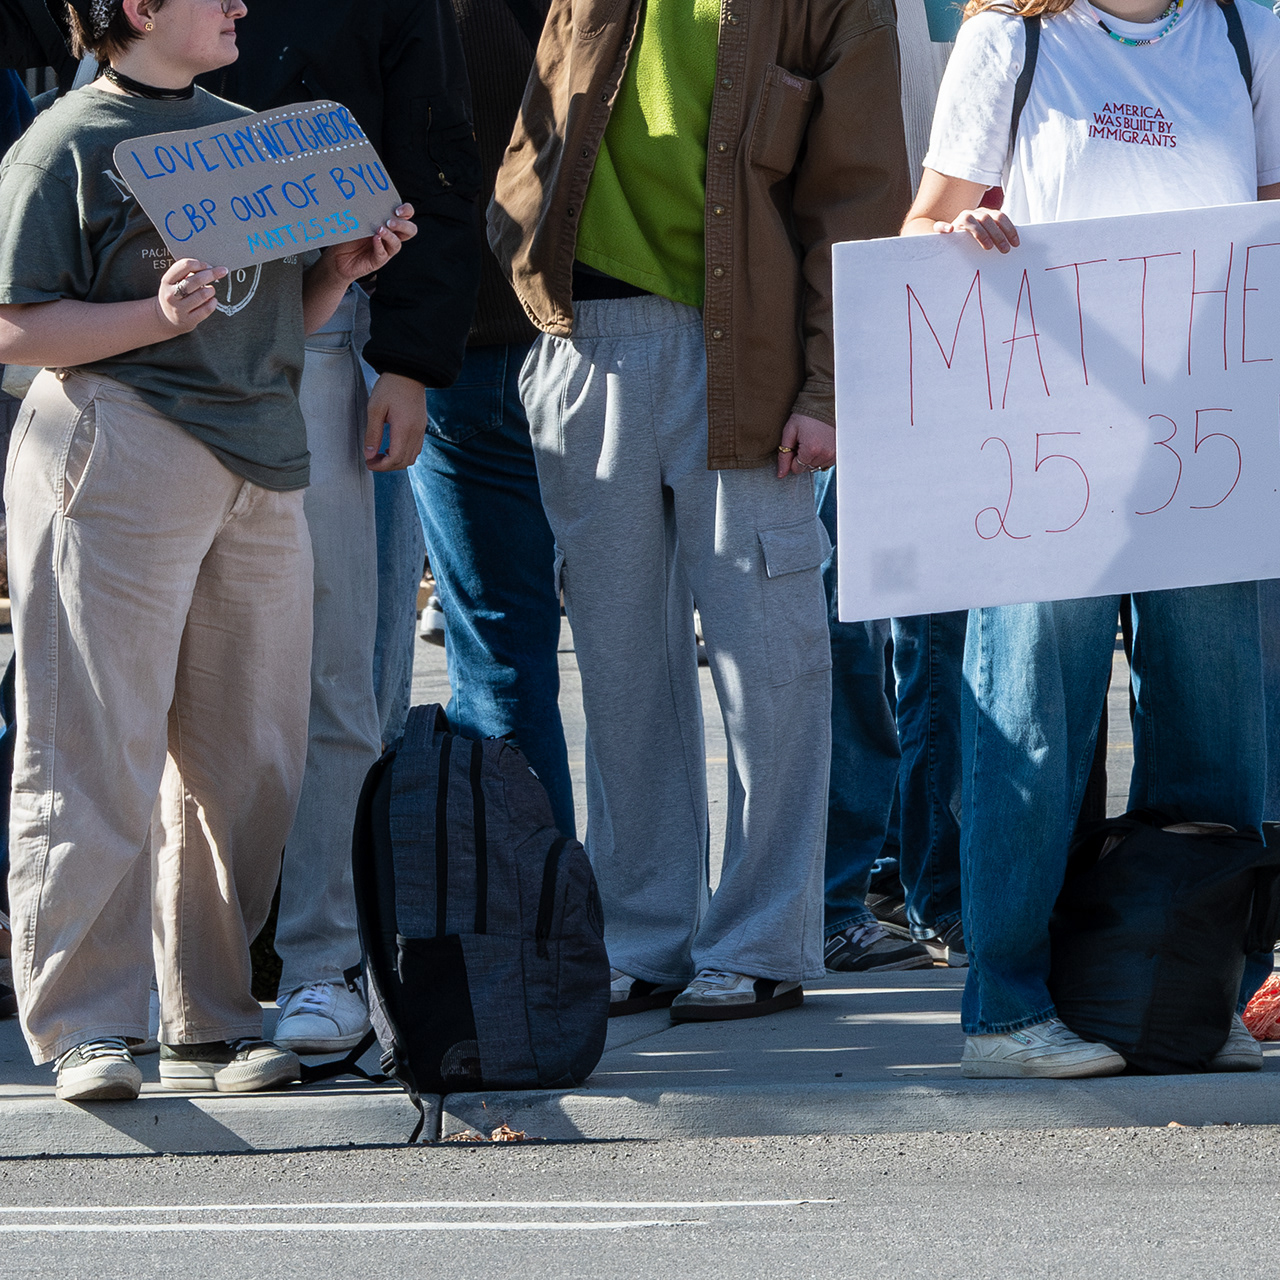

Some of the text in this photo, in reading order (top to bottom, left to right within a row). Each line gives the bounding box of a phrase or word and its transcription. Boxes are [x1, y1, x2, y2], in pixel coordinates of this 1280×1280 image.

[1093, 112, 1174, 134] WAS BUILT BY
[1102, 102, 1165, 119] AMERICA
[131, 106, 365, 181] LOVE THY NEIGHBOR
[1088, 124, 1177, 148] IMMIGRANTS
[164, 161, 390, 242] CBP OUT OF BYU
[246, 223, 299, 255] MATT
